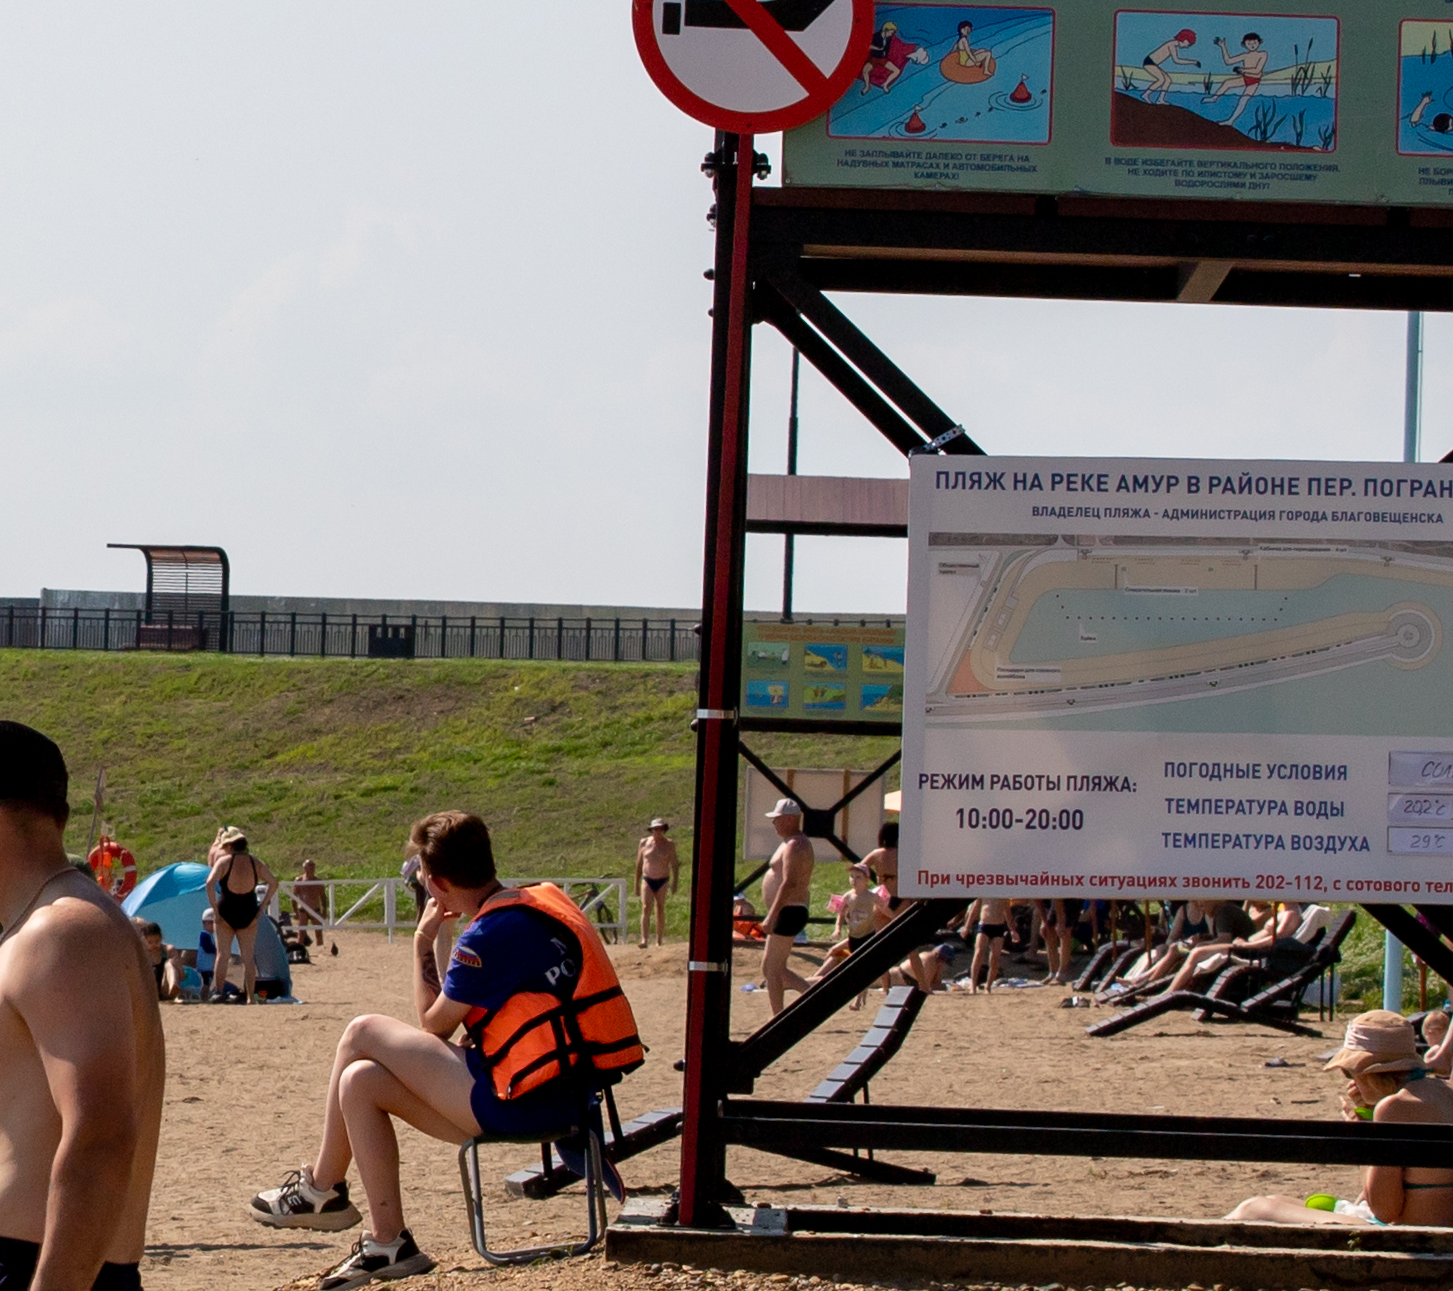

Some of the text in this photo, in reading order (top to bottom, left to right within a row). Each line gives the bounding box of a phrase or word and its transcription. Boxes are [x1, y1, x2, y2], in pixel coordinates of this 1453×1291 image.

[837, 159, 889, 169] НАДУВНЫХ
[892, 160, 940, 170] МАТРАСАХ
[952, 162, 1037, 172] АВТОМОБИЛЬНЫХ
[860, 150, 922, 159] ЗАПЛЫВАЙТЕ
[925, 152, 962, 160] ДАЛЕКО
[980, 153, 1014, 162] БЕРЕГА
[935, 471, 1005, 490] ПЛЯЖ
[1013, 472, 1043, 491] НА
[1050, 472, 1109, 492] РЕКЕ
[1115, 474, 1179, 493] АМУР
[1186, 475, 1200, 494] В
[1208, 472, 1300, 495] РАЙОНЕ
[1307, 477, 1355, 496] ПЕР.
[1031, 506, 1101, 519] ВЛАДЕЛЕЦ
[1103, 507, 1151, 518] ПЛЯЖА
[1161, 508, 1275, 521] АДМИНИСТРАЦИЯ
[1278, 510, 1328, 523] ГОРОДА
[1330, 511, 1443, 523] БЛАГОВЕЩЕНСКА
[1164, 761, 1347, 781] ПОГОДНЫЕ УСЛОВИЯ
[918, 773, 1136, 792] РЕЖИМ РАБОТЫ ПЛЯЖА:
[956, 807, 1084, 830] 10:00-20:00
[1164, 797, 1344, 819] ТЕМПЕРАТУРА ВОДЫ
[1161, 832, 1370, 854] ТЕМПЕРАТУРА ВОЗДУХА
[917, 870, 950, 888] При
[955, 871, 1084, 887] чрезвычайных
[1088, 875, 1177, 889] ситуациях
[1182, 876, 1250, 888] звонить
[1255, 874, 1327, 891] 202-112,
[1332, 879, 1341, 890] с
[1345, 880, 1420, 892] сотового
